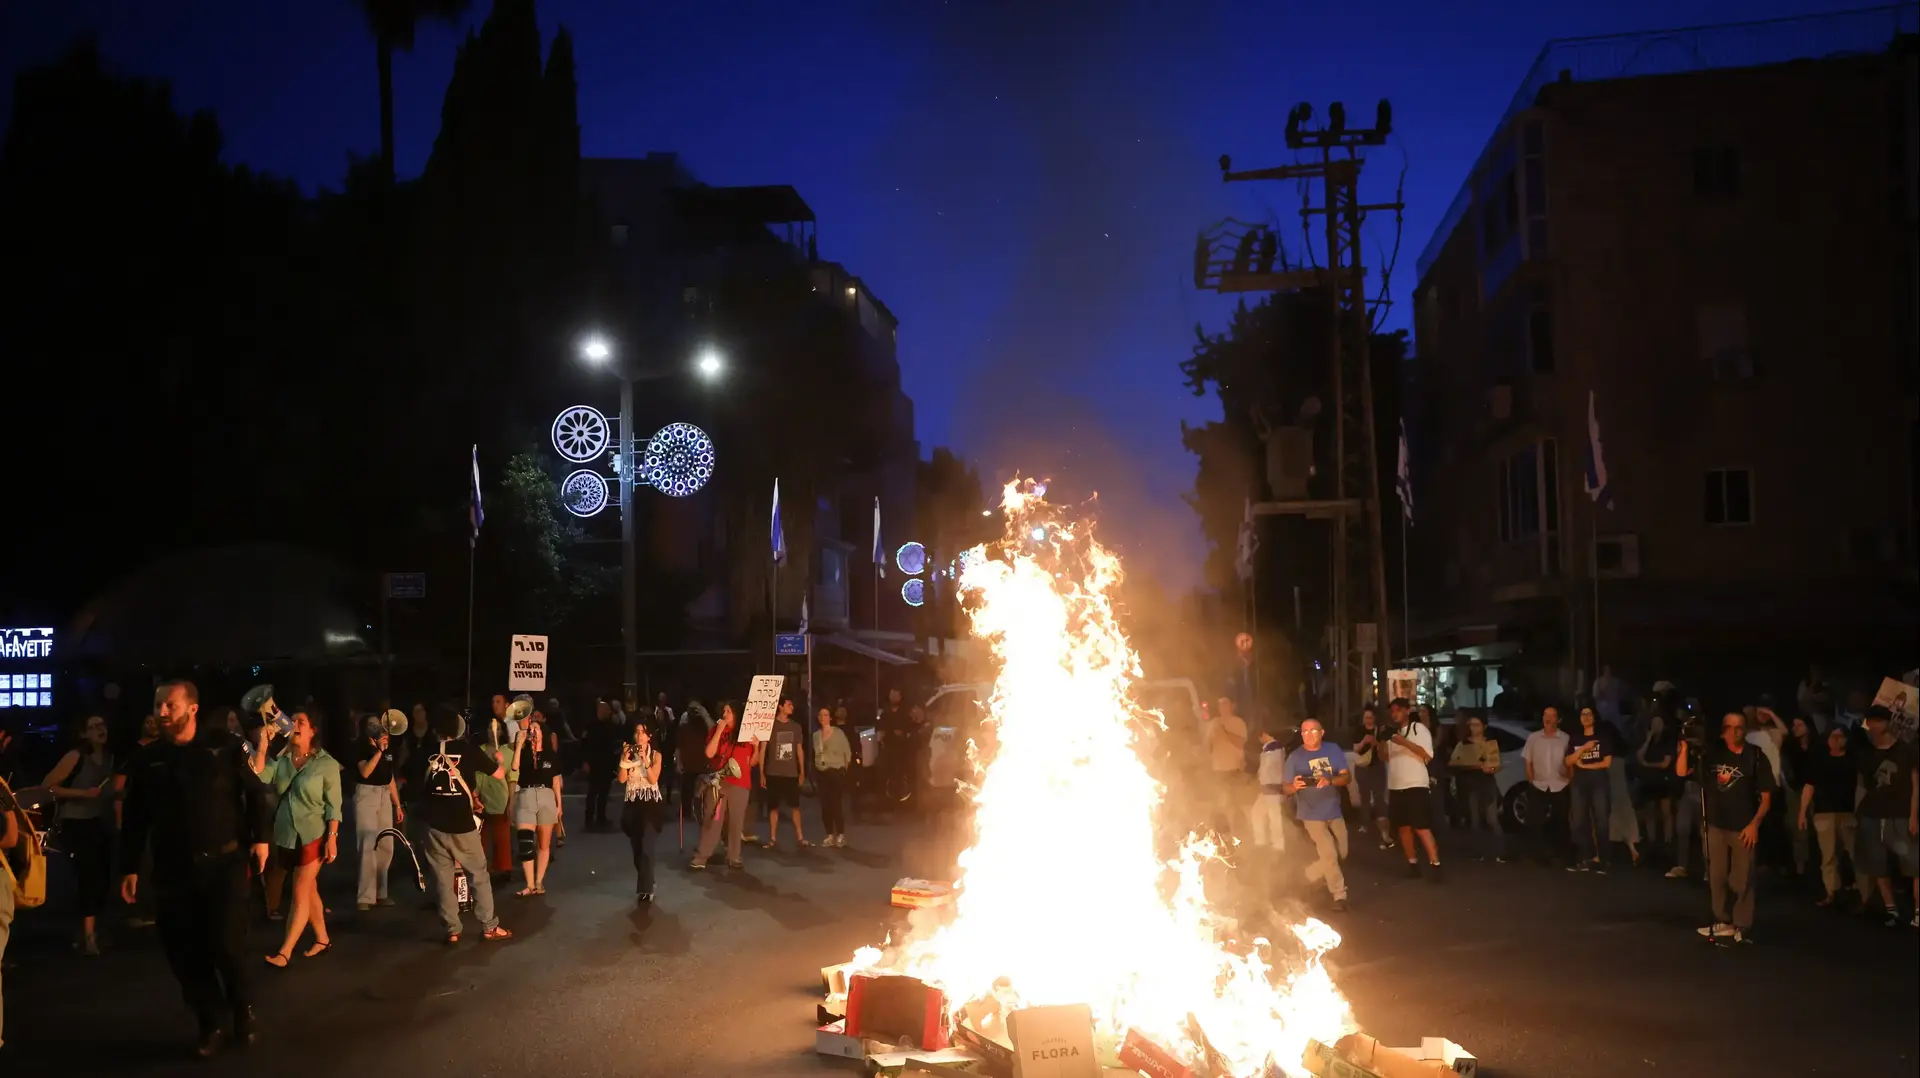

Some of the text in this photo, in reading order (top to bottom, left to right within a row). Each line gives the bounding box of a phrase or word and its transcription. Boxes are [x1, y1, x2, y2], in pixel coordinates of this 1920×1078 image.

[514, 660, 543, 669] ממשלת
[513, 670, 544, 679] נתניהו
[1031, 1046, 1080, 1061] FLORA
